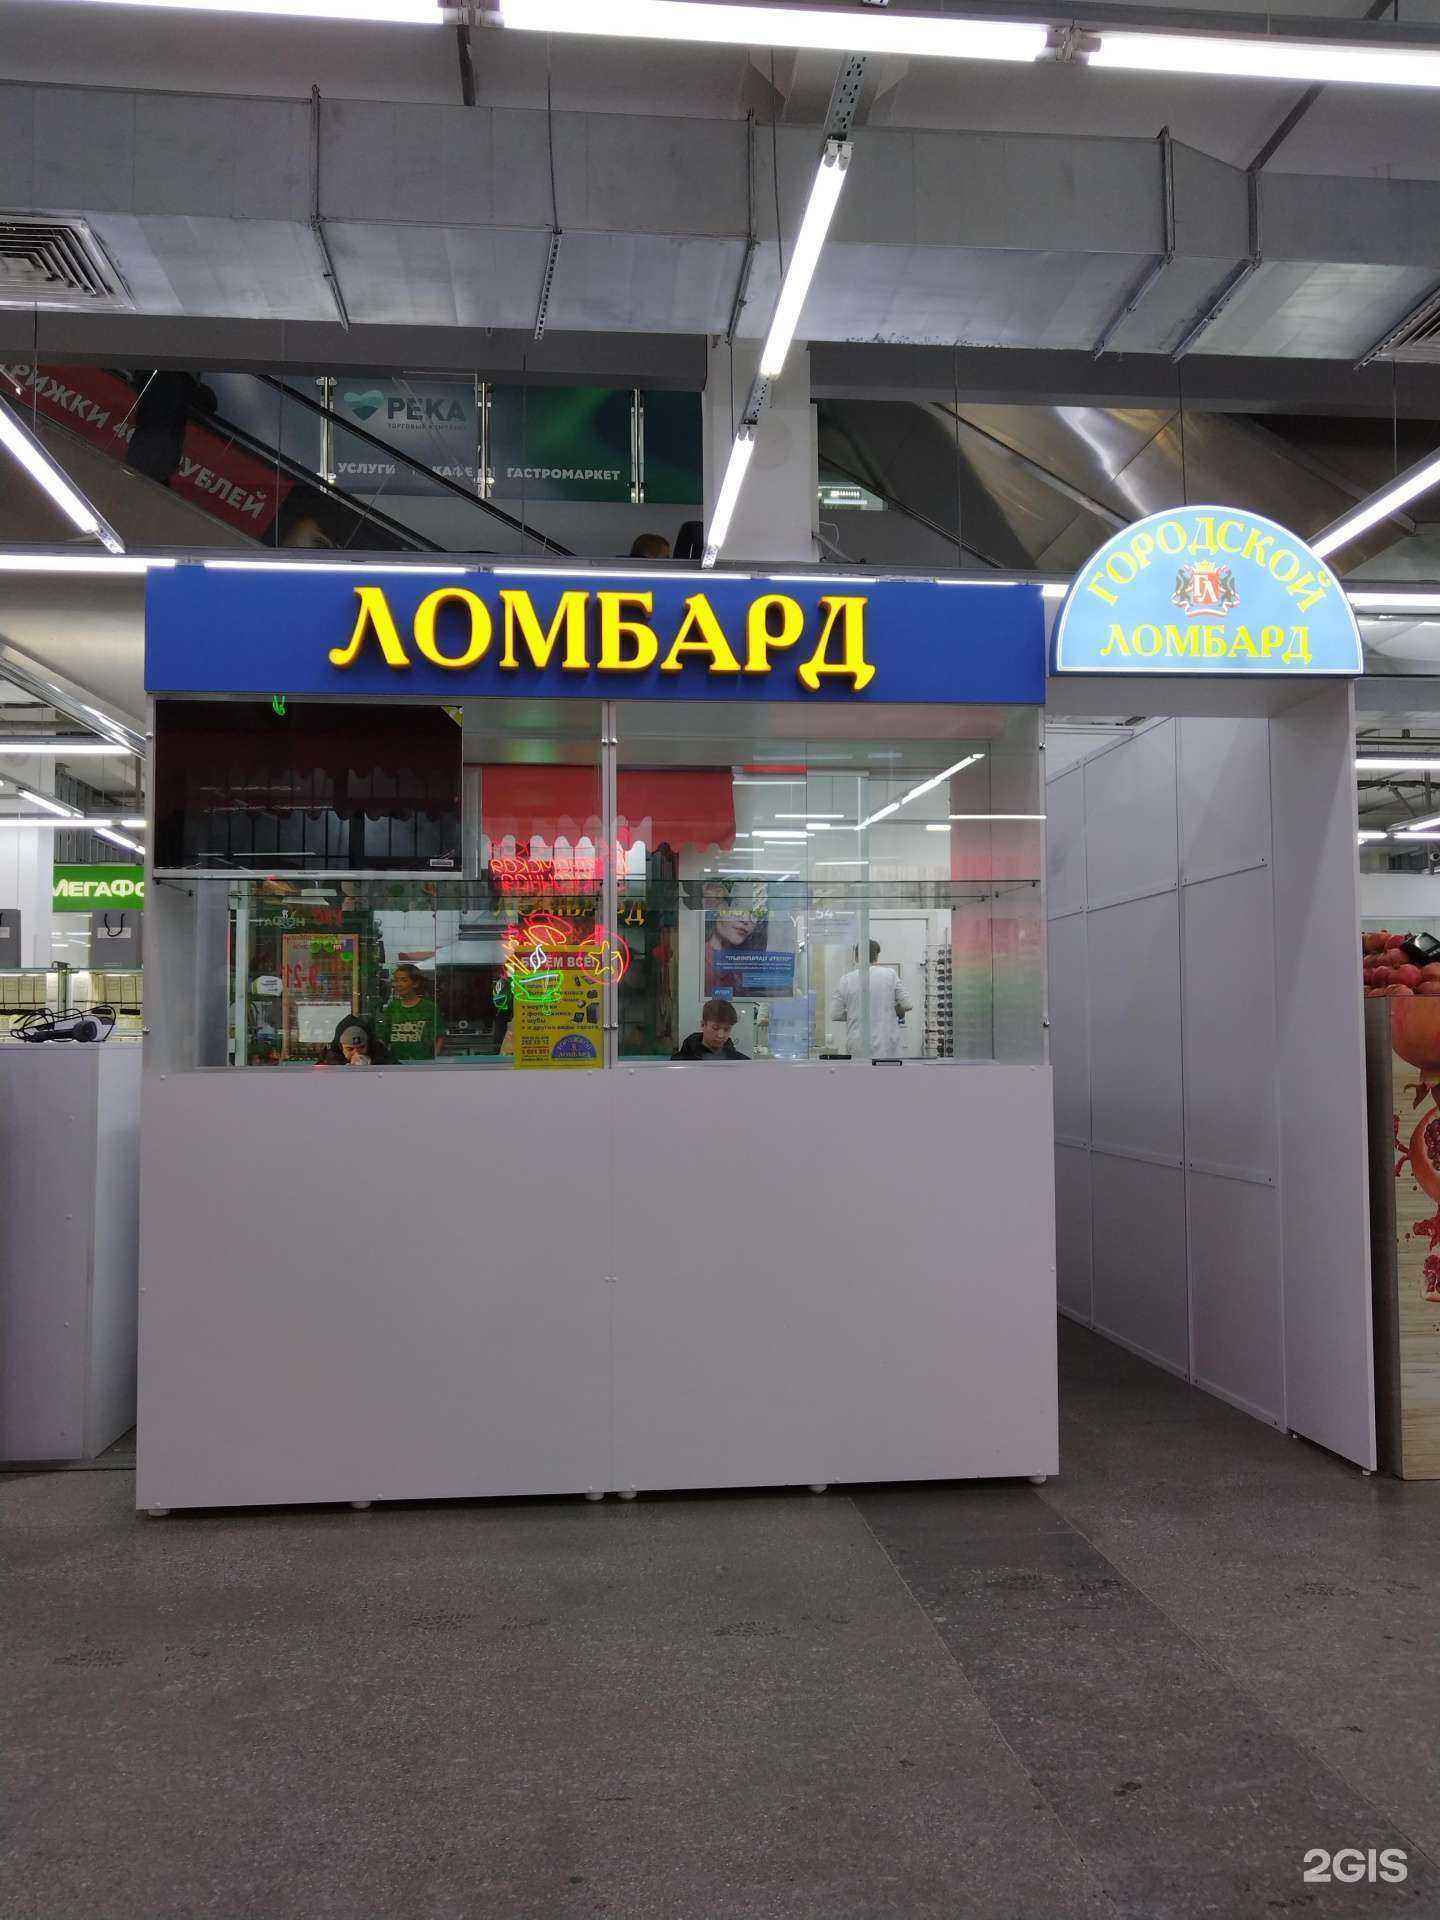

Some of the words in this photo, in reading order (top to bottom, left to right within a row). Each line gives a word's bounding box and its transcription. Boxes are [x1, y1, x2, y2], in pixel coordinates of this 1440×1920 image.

[387, 397, 466, 422] РЕКА
[179, 455, 267, 520] УБЛЕЙ
[337, 462, 396, 475] УСЛУГИ
[506, 467, 621, 481] ГАСТРОМАРКЕТ
[1087, 516, 1333, 614] ГОРОДСКОЙ
[328, 585, 877, 693] ЛОМБАРД
[1099, 623, 1313, 666] ЛОМБАРД
